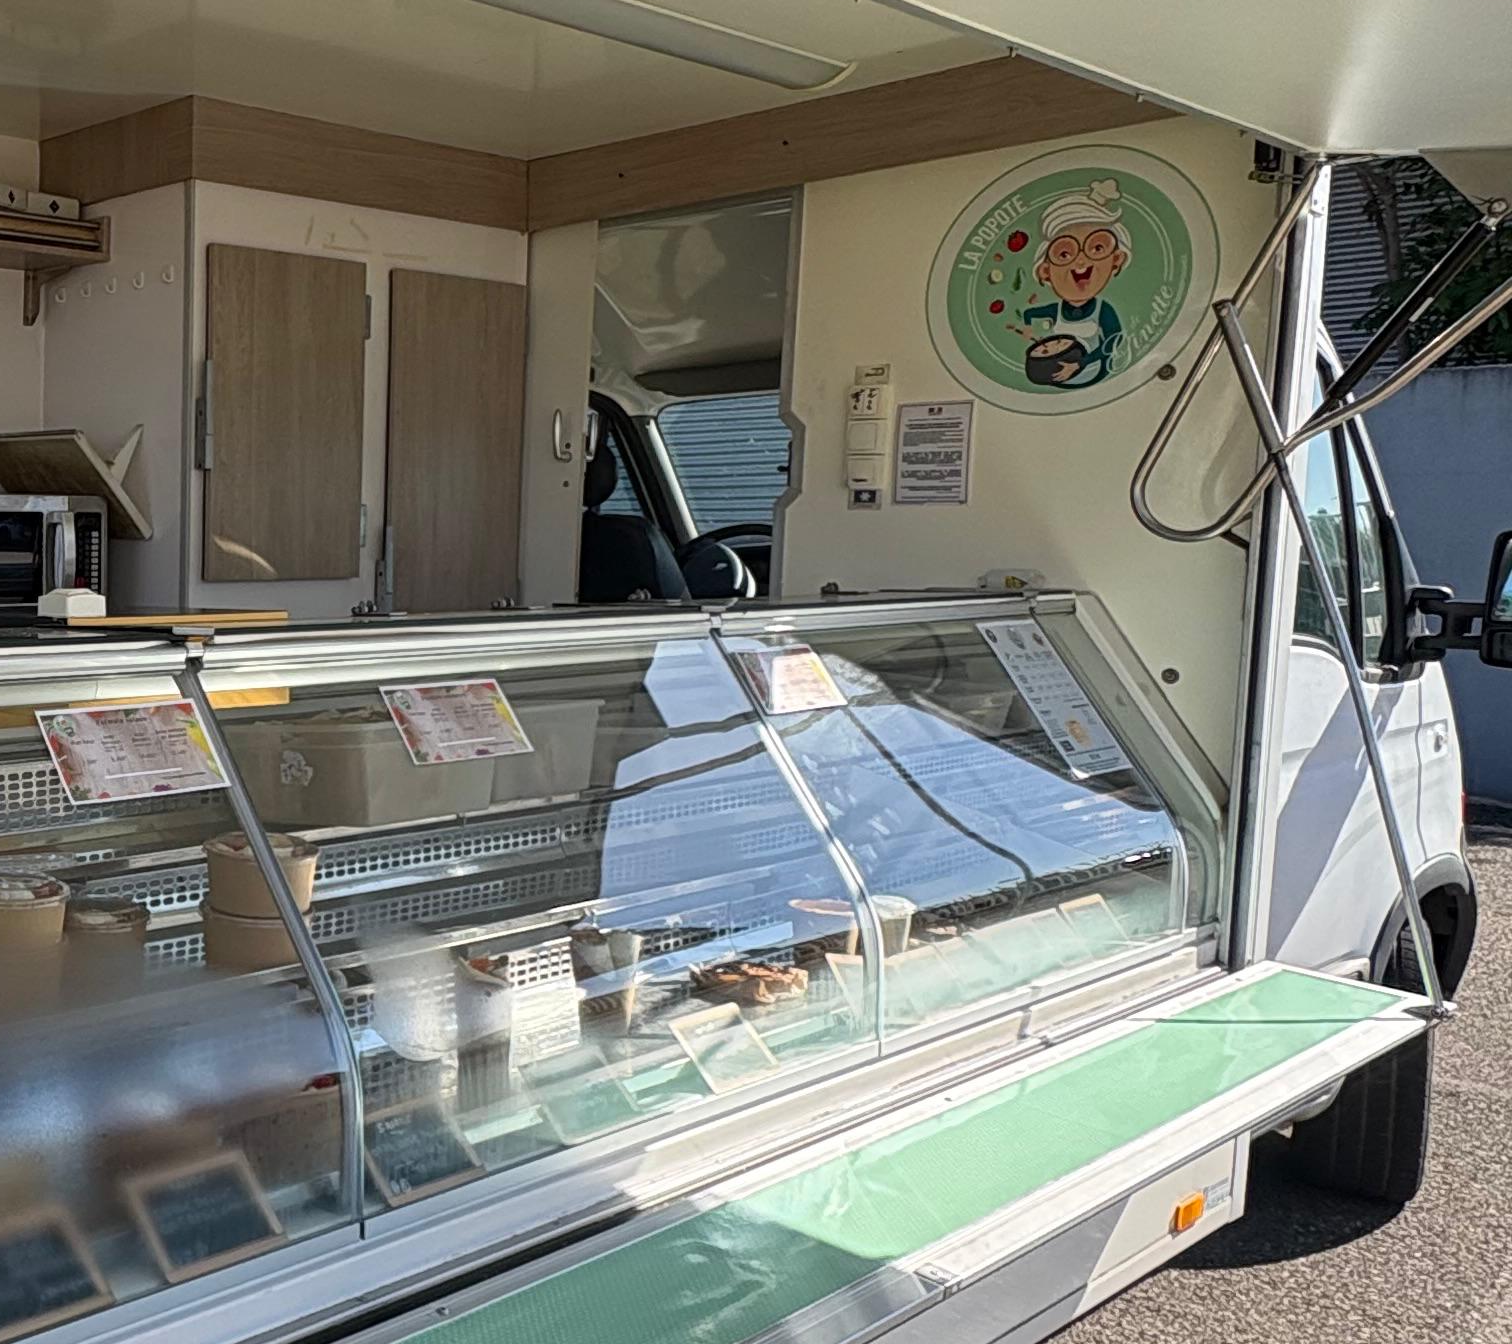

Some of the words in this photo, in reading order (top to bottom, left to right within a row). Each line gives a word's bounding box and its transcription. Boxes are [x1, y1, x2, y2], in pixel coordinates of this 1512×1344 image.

[970, 194, 1029, 251] POPOTE
[958, 252, 985, 271] LA
[1101, 285, 1173, 374] Ginette
